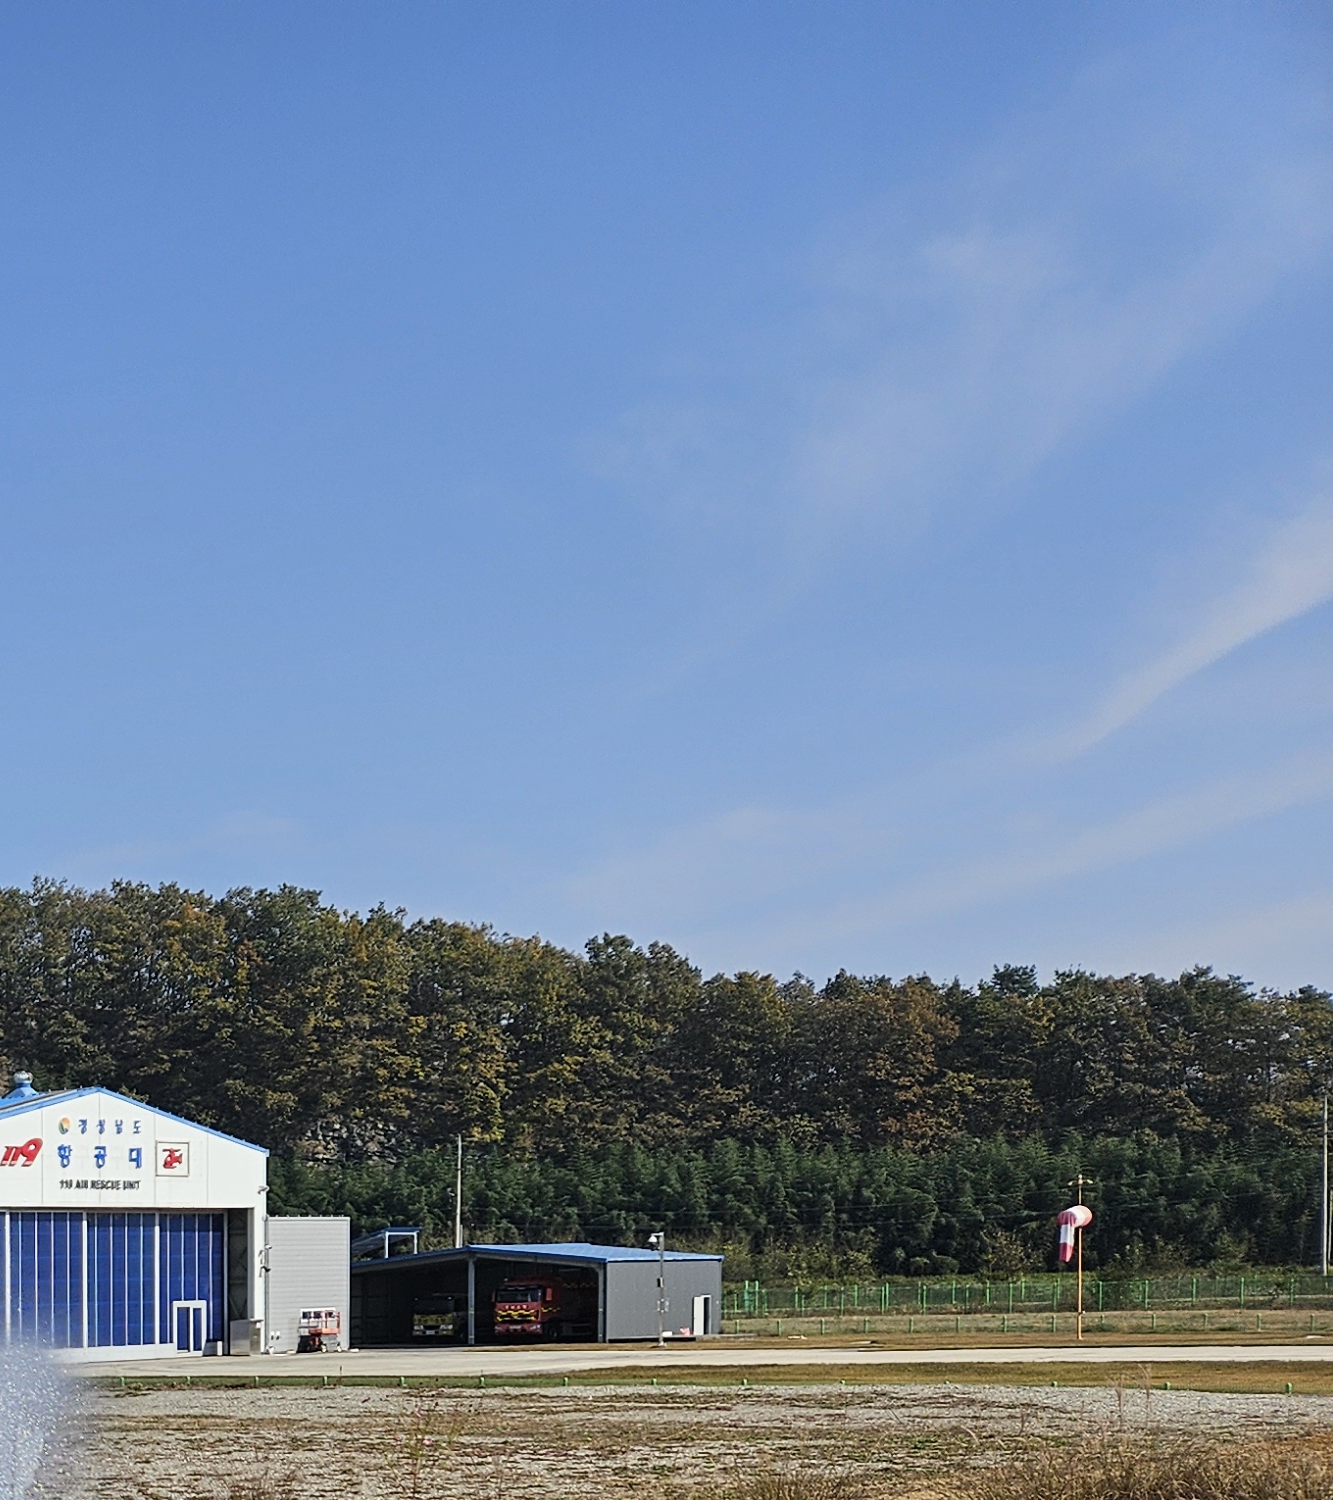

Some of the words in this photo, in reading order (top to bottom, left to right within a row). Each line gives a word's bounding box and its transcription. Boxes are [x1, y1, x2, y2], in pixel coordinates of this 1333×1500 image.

[77, 1118, 142, 1135] 경상남도
[0, 1137, 44, 1168] 119
[56, 1143, 143, 1170] 항공대
[74, 1179, 89, 1190] AIR
[90, 1179, 122, 1191] RESCUE
[122, 1180, 141, 1191] UNIT
